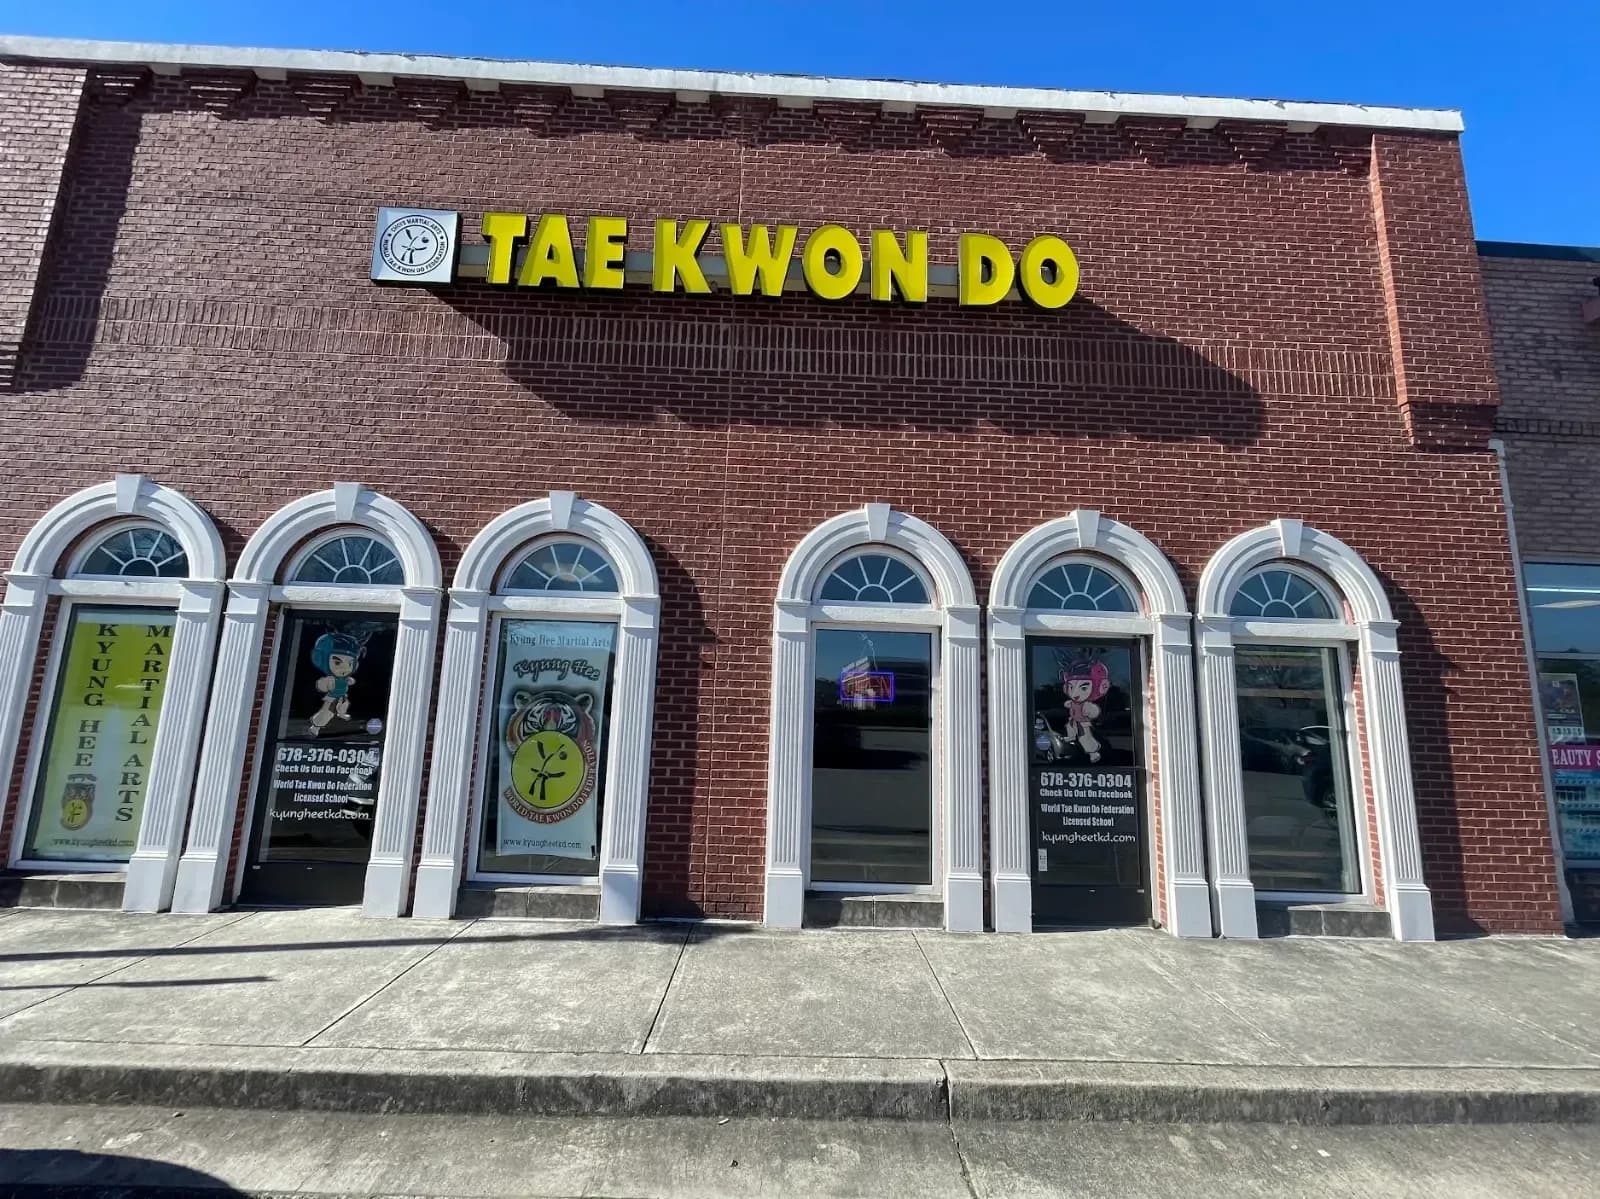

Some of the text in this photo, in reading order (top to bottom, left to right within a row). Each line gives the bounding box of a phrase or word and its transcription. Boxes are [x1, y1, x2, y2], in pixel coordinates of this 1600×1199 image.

[406, 217, 430, 226] MARTIAL
[430, 222, 442, 235] ARTS
[382, 239, 390, 258] WORLD
[387, 257, 398, 268] TAE
[397, 265, 415, 273] KWON
[425, 241, 446, 269] FEDERATION
[481, 210, 1081, 309] TAE KWON DO
[510, 634, 536, 647] Kyung
[539, 634, 556, 645] Hee
[557, 635, 589, 647] Martial
[83, 623, 120, 707] KYUNG
[513, 657, 601, 682] Kyung Hee
[115, 624, 173, 822] MARTIAL ARTS
[74, 719, 102, 767] HEE
[1551, 748, 1592, 766] EAUTY
[275, 764, 373, 775] Check Us Out On Facebook
[273, 779, 373, 791] World Tae Kwon Do Federation
[503, 740, 597, 824] WORLD TAE KWON DO FEDERATION
[1040, 772, 1132, 788] 678-376-0304
[294, 792, 349, 804] Licensed School
[1039, 788, 1133, 799] Check Us Out On Facebook
[269, 808, 370, 821] kyungheetkd.com
[1040, 803, 1135, 815] World Tae Kwon Do Federation
[1062, 816, 1114, 827] Licensed School
[1042, 831, 1136, 844] kyungheetkd.com
